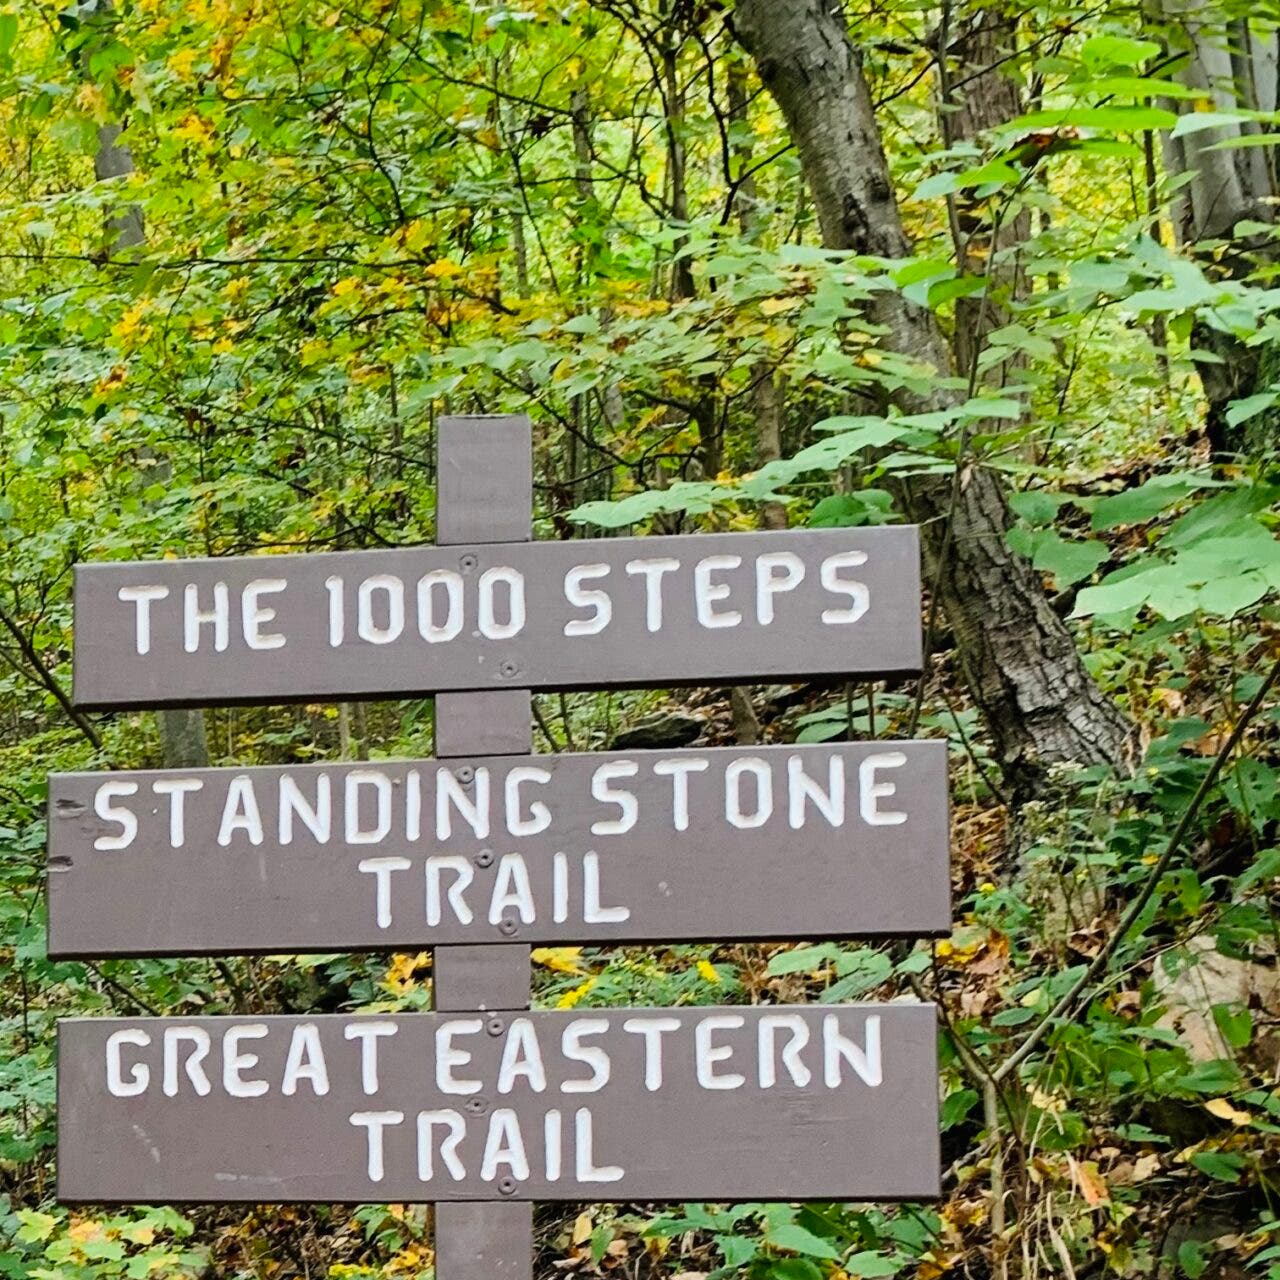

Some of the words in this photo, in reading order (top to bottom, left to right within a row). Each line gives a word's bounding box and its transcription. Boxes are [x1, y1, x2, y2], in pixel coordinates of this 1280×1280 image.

[119, 578, 288, 656] THE
[327, 565, 526, 646] 1000
[563, 549, 871, 637] STEPS
[93, 765, 553, 851] STANDING
[590, 751, 908, 836] STONE
[358, 850, 631, 929] TRAIL
[105, 1019, 399, 1098] GREAT
[435, 1013, 883, 1096] EASTERN
[348, 1107, 625, 1183] TRAIL
